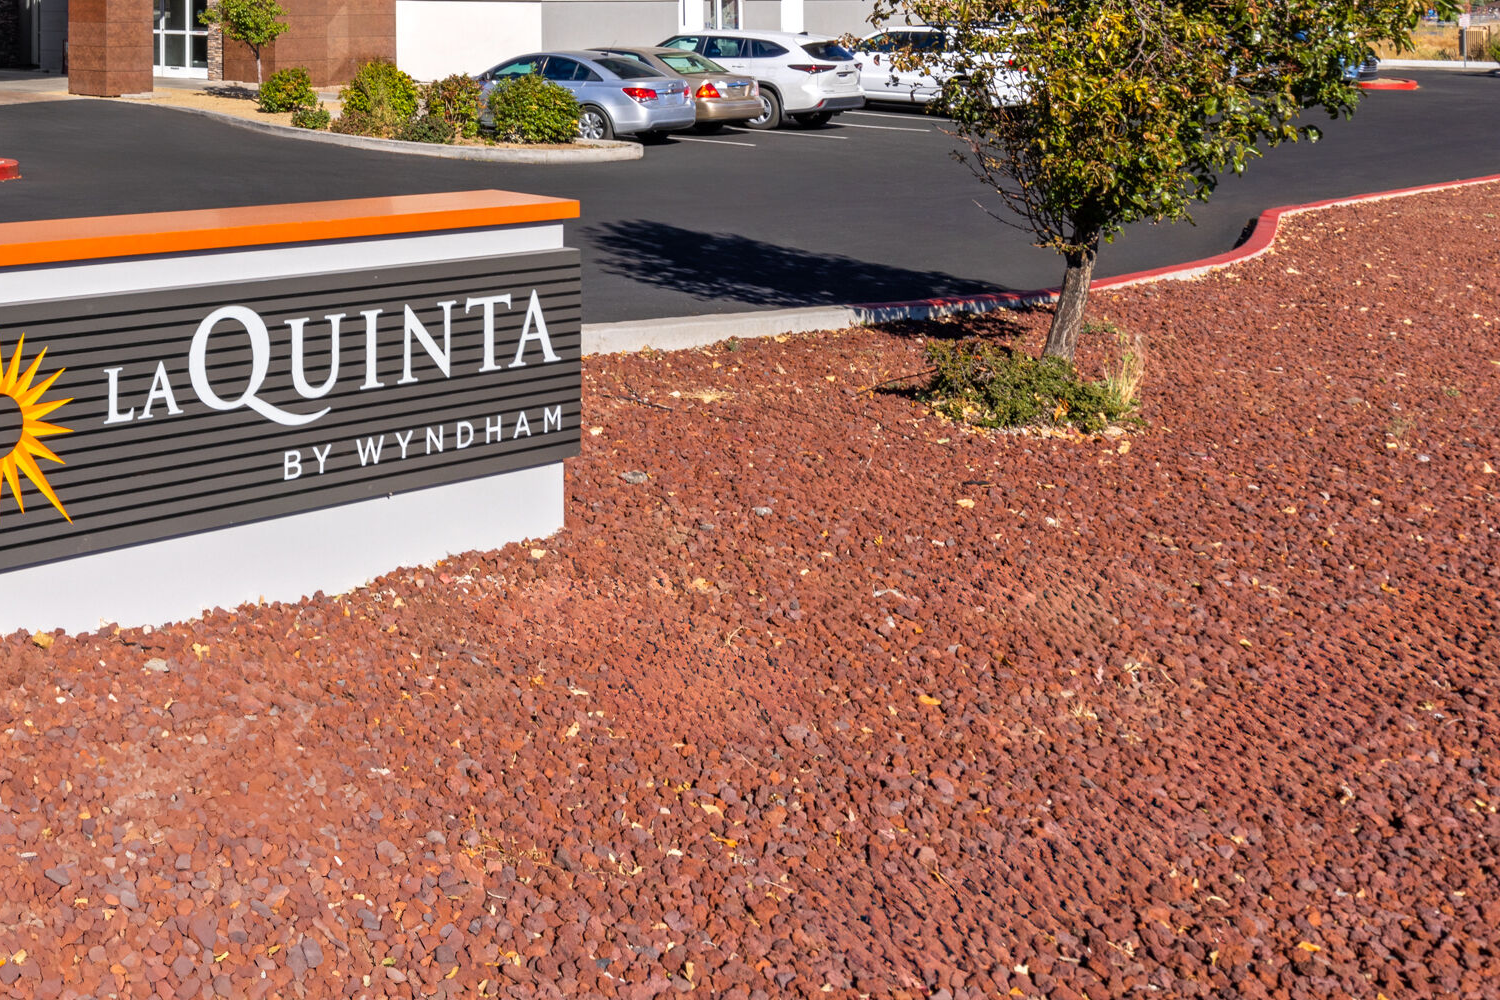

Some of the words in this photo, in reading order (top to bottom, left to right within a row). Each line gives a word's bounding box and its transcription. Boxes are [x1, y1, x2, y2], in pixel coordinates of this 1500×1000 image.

[103, 360, 183, 426] LA
[188, 289, 562, 426] QUINTA
[284, 443, 332, 481] BY
[356, 405, 564, 467] WYNDHAM
